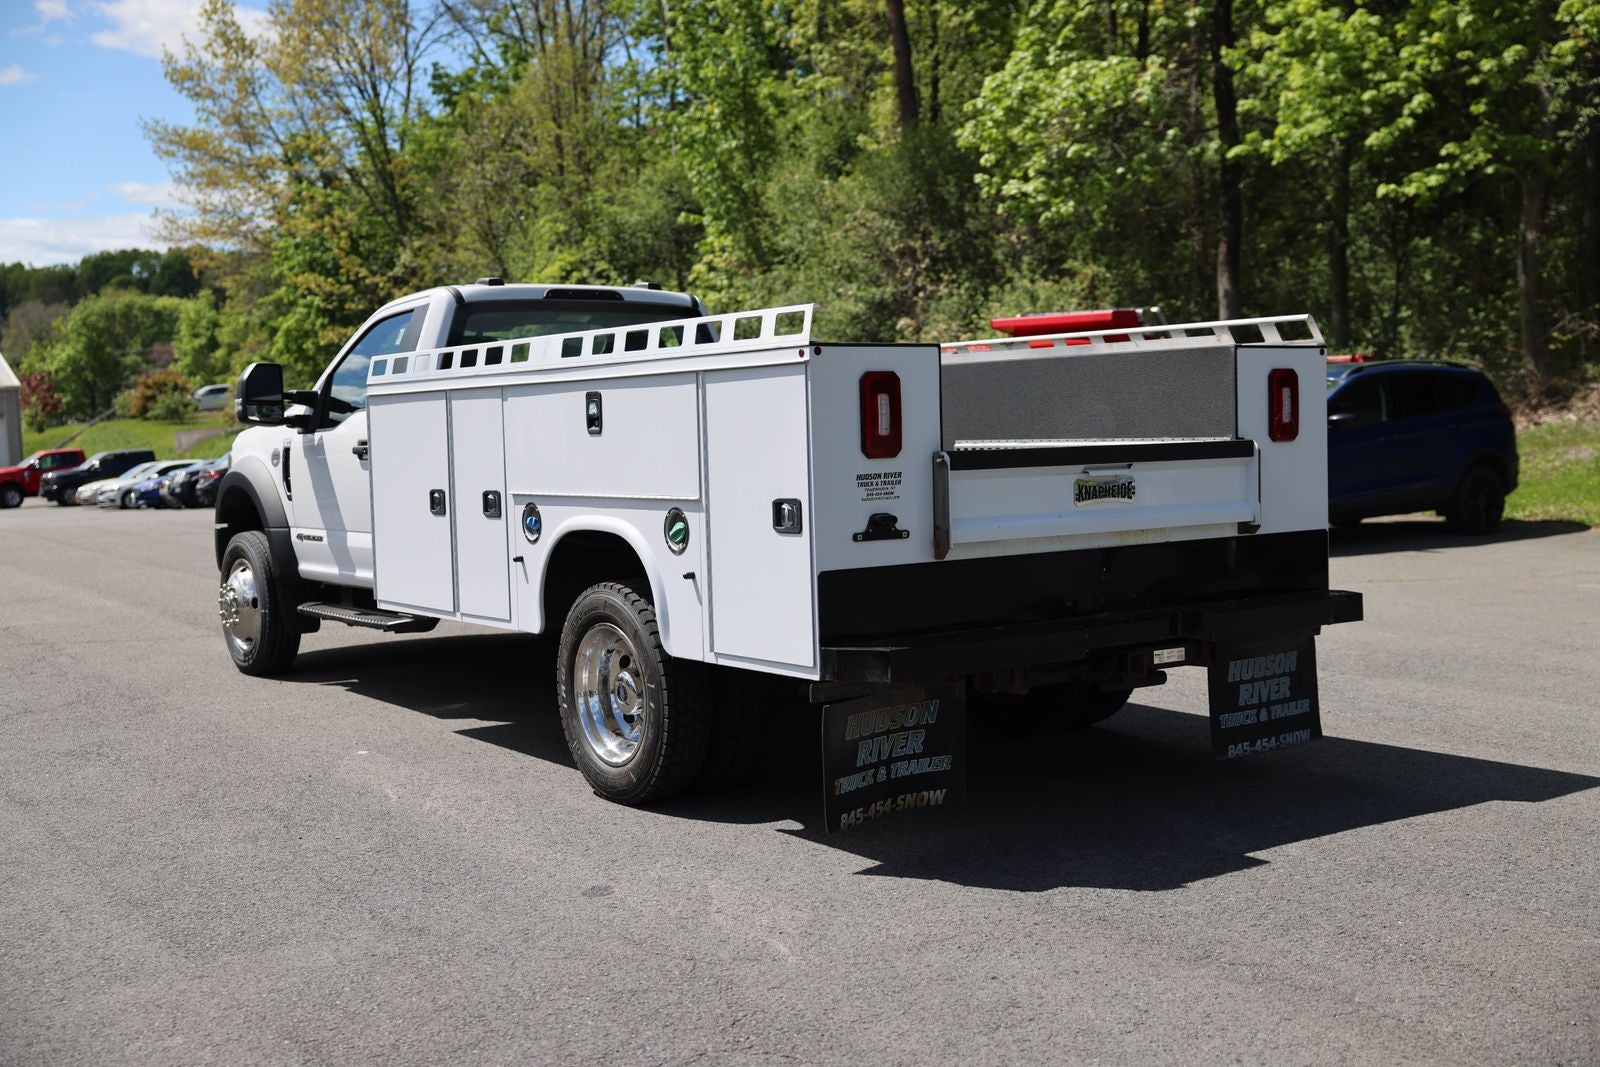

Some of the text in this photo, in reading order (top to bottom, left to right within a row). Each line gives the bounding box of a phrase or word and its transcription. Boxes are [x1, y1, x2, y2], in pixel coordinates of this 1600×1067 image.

[856, 473, 882, 481] HUDSON
[1077, 481, 1133, 502] KNAPHEIDE
[1227, 651, 1298, 683] HUDSON
[1238, 676, 1291, 706] RIVER
[845, 700, 940, 740] HUDSON
[1220, 699, 1310, 729] TRUCK & TRAILER
[856, 729, 926, 767] RIVER
[1227, 728, 1311, 758] 845-454-SNOW
[834, 755, 952, 796] TRUCK & TRAILER
[840, 789, 947, 830] 845-454-SNOW
